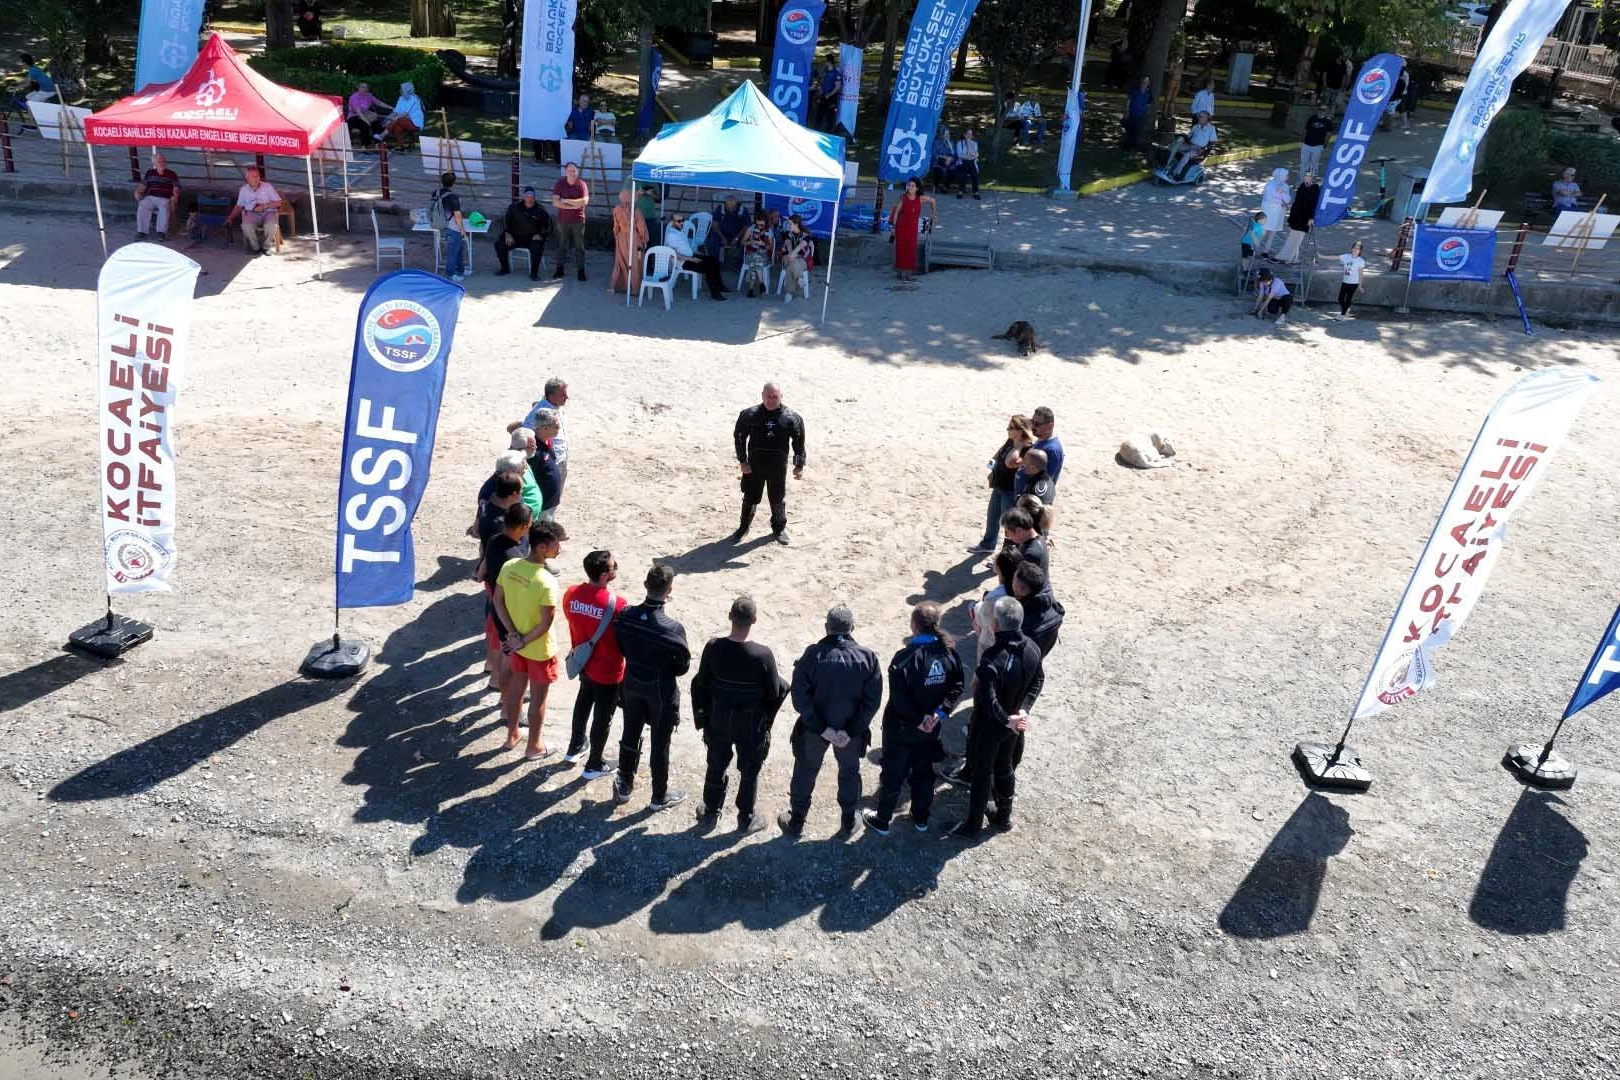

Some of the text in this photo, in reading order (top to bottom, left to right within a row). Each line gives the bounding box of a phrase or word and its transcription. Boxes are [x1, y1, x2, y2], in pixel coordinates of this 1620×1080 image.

[773, 58, 804, 124] SF
[894, 26, 923, 103] KOCAELİ
[919, 11, 957, 109] BELEDİYESİ
[93, 125, 122, 138] KOCAELİ
[156, 128, 167, 139] SU
[167, 128, 199, 140] KAZALARI
[200, 129, 239, 143] ENGELLEME
[240, 132, 268, 146] MERKEZİ
[1320, 119, 1371, 210] TSSF
[384, 346, 418, 360] TSSF
[107, 313, 139, 522] KOCAELİ
[137, 322, 174, 527] İTFAİYESİ
[341, 398, 418, 573] TSSF
[1403, 438, 1520, 643] KOCAELİ
[570, 599, 604, 617] TÜRKİYE
